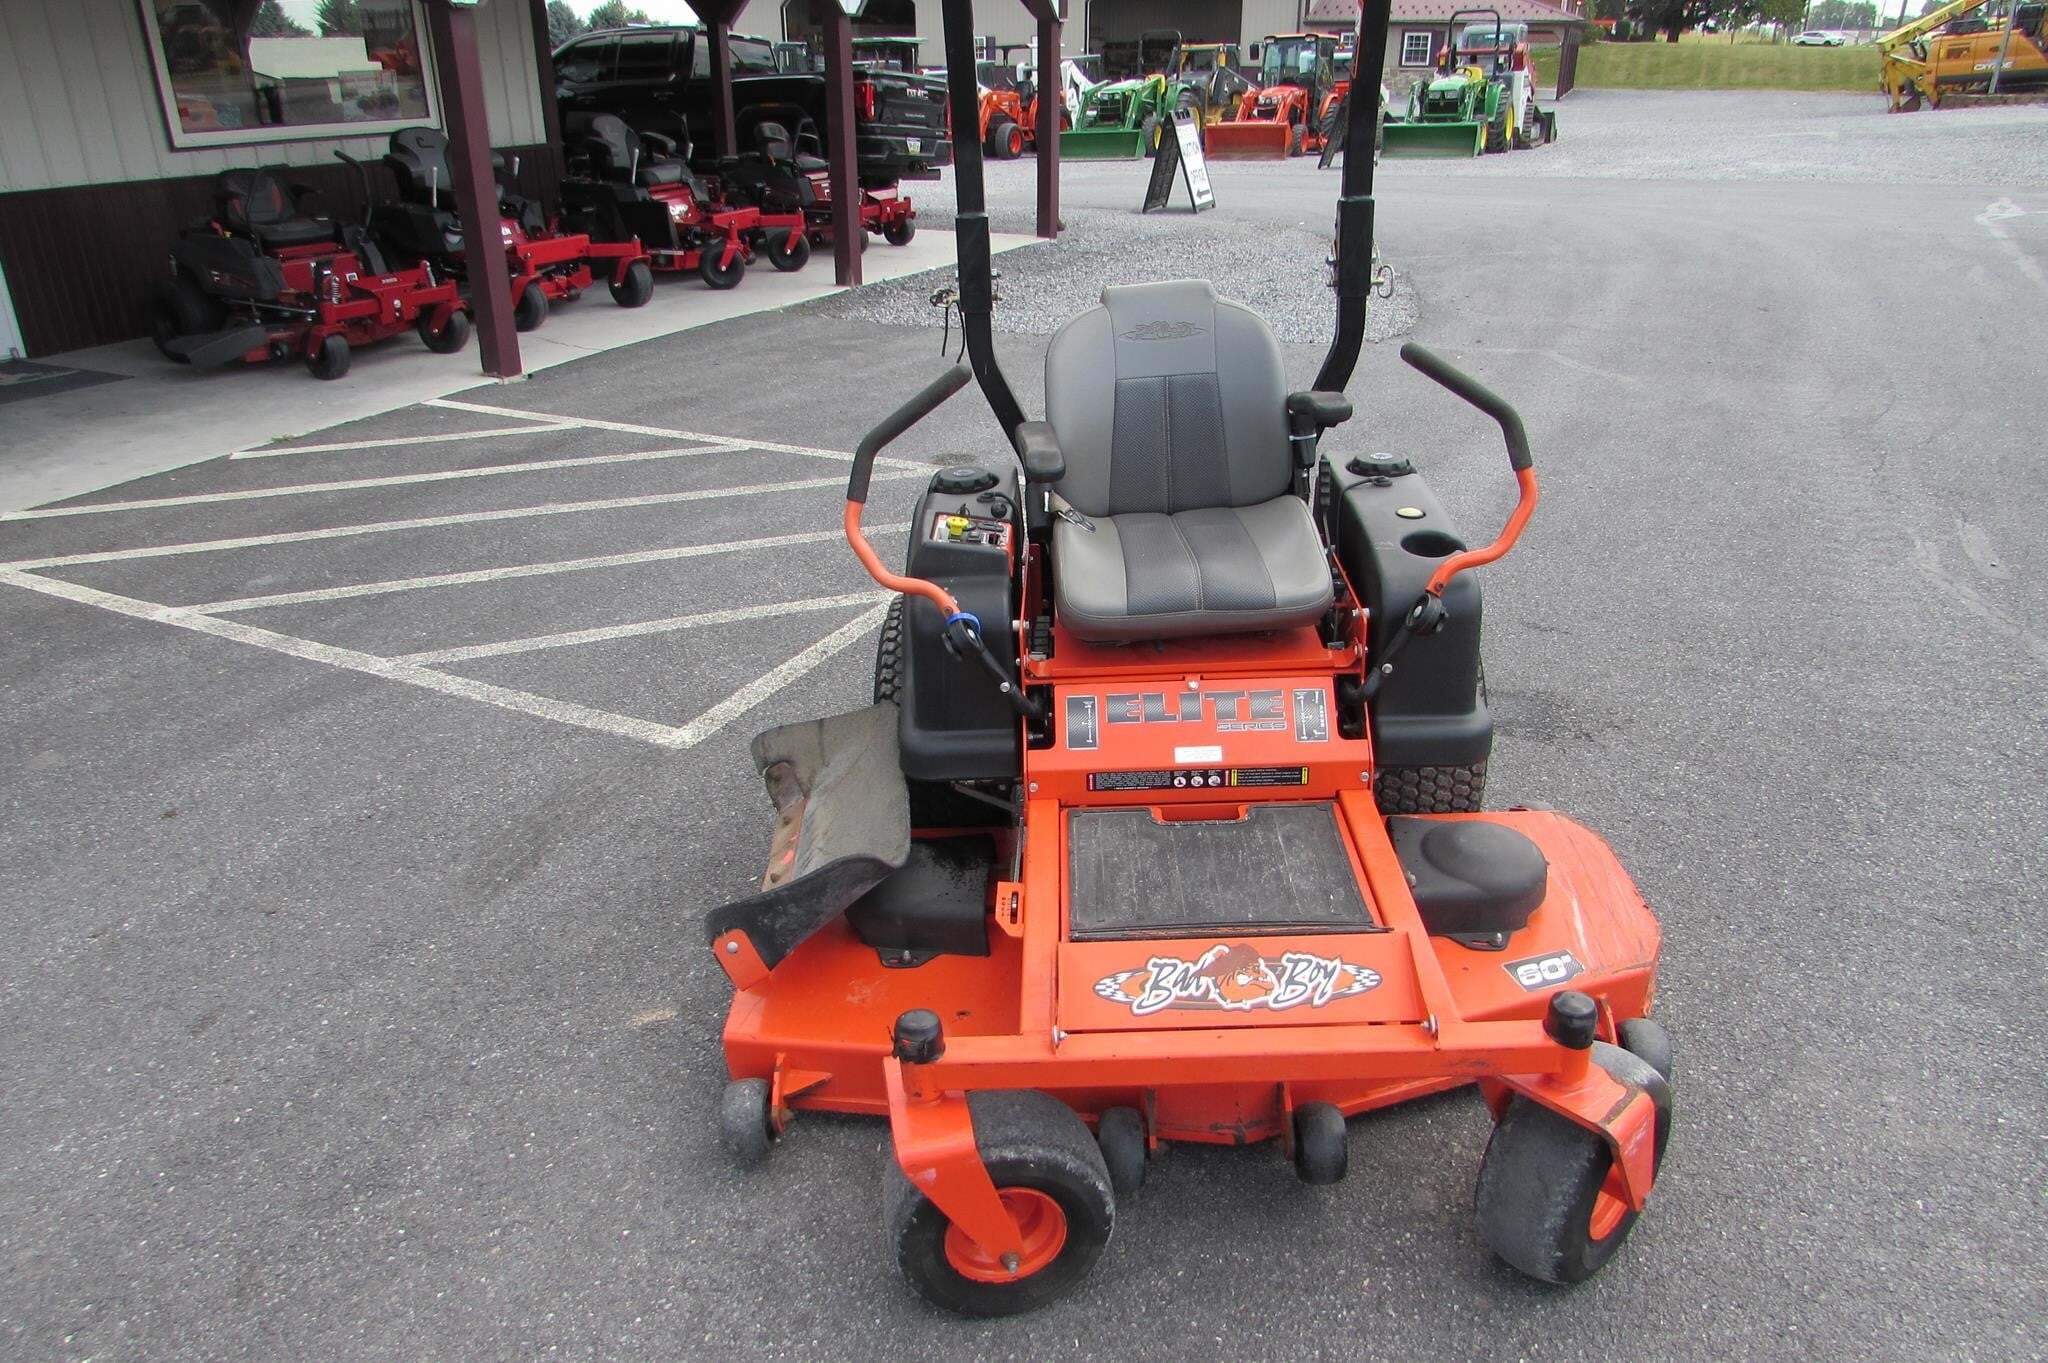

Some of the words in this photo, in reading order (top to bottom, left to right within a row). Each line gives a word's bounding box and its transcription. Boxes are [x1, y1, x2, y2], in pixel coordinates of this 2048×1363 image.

[1106, 690, 1286, 723] ELITE
[1217, 721, 1287, 732] SERIES
[1134, 956, 1210, 1013] Bad
[1270, 954, 1340, 1007] Boy
